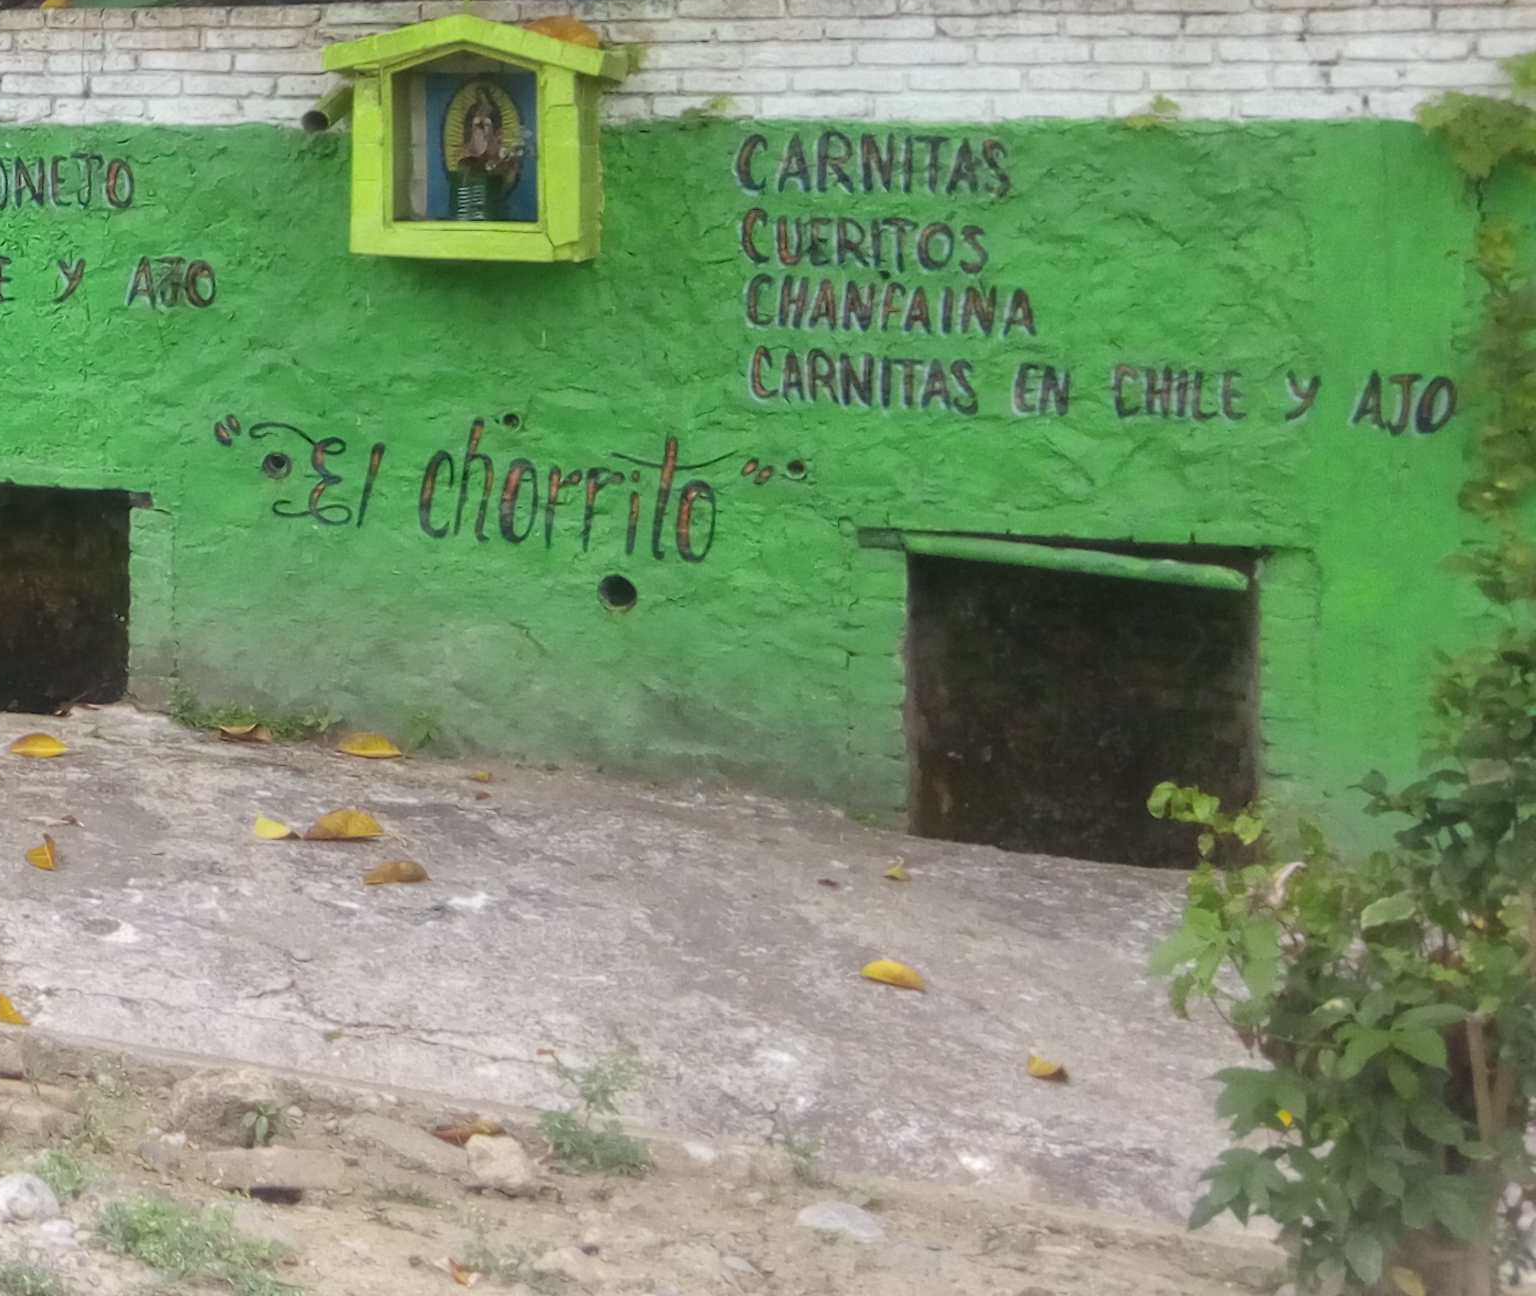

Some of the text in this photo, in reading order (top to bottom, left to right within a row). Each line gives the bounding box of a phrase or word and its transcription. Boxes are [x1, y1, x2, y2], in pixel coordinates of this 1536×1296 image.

[732, 130, 1012, 200] CARNITAS
[739, 207, 990, 275] CUERITOS
[55, 256, 87, 305] Y
[125, 255, 217, 308] AJO
[743, 272, 1039, 338] CHANFAINA
[748, 345, 1459, 437] CARNITAS EN CHILE Y AJO
